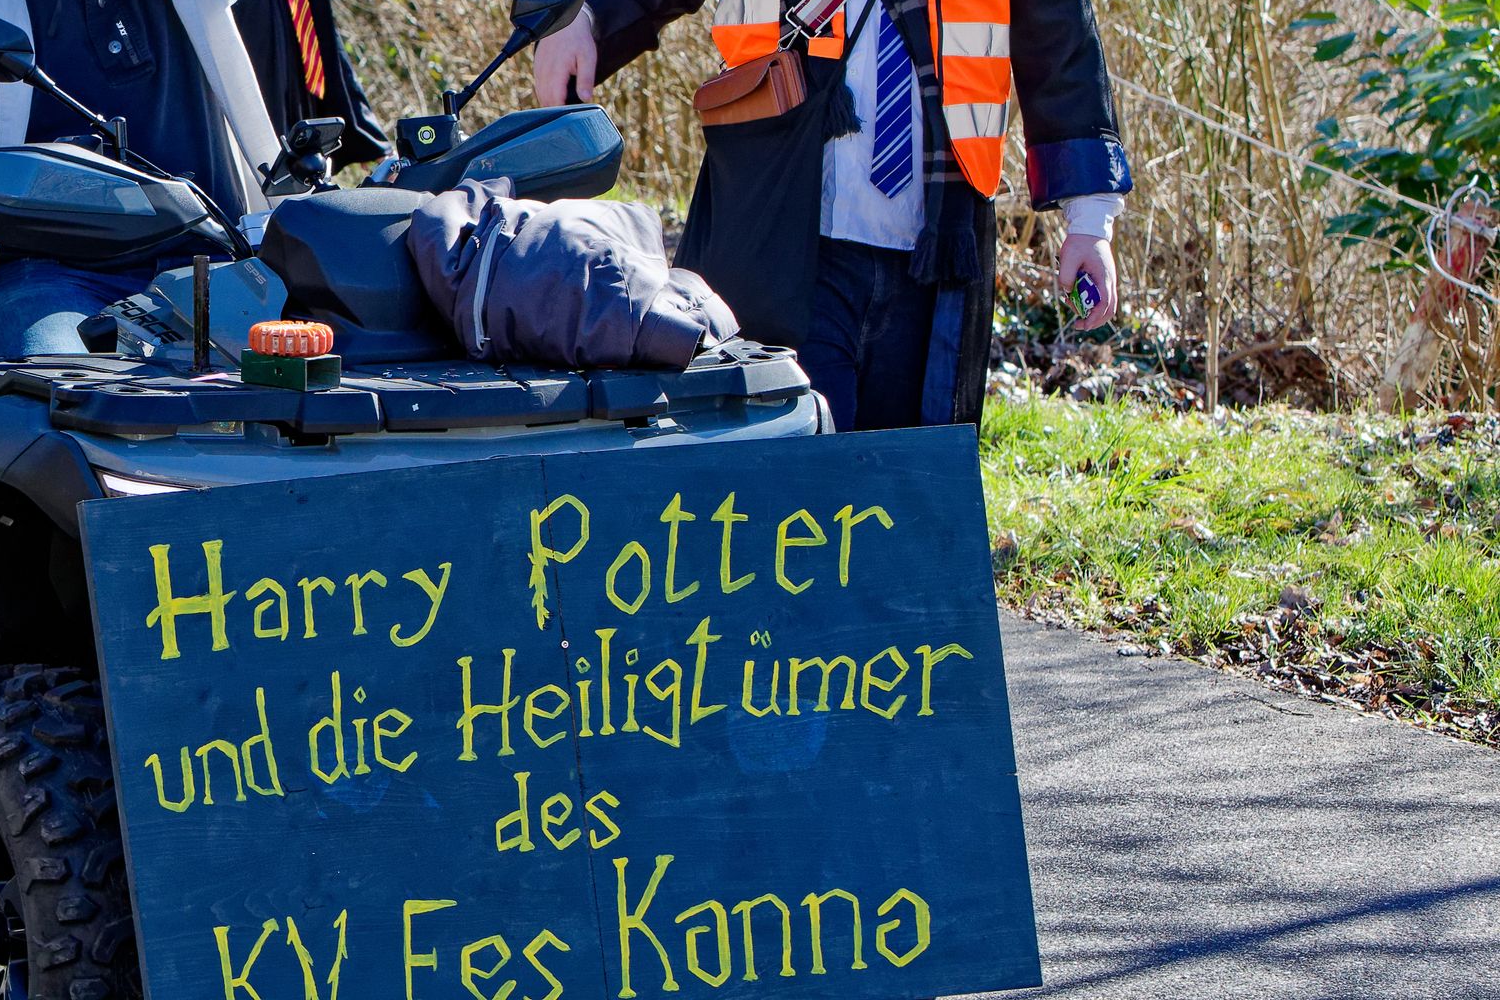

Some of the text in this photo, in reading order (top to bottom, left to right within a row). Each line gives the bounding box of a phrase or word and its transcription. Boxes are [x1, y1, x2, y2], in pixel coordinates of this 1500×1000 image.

[112, 298, 187, 345] FORCE
[243, 261, 267, 285] EPS
[146, 491, 895, 660] Harry Potter
[144, 615, 974, 813] und die Heiligtümer
[495, 771, 621, 852] des
[212, 854, 932, 1000] KV Fes Kanna
